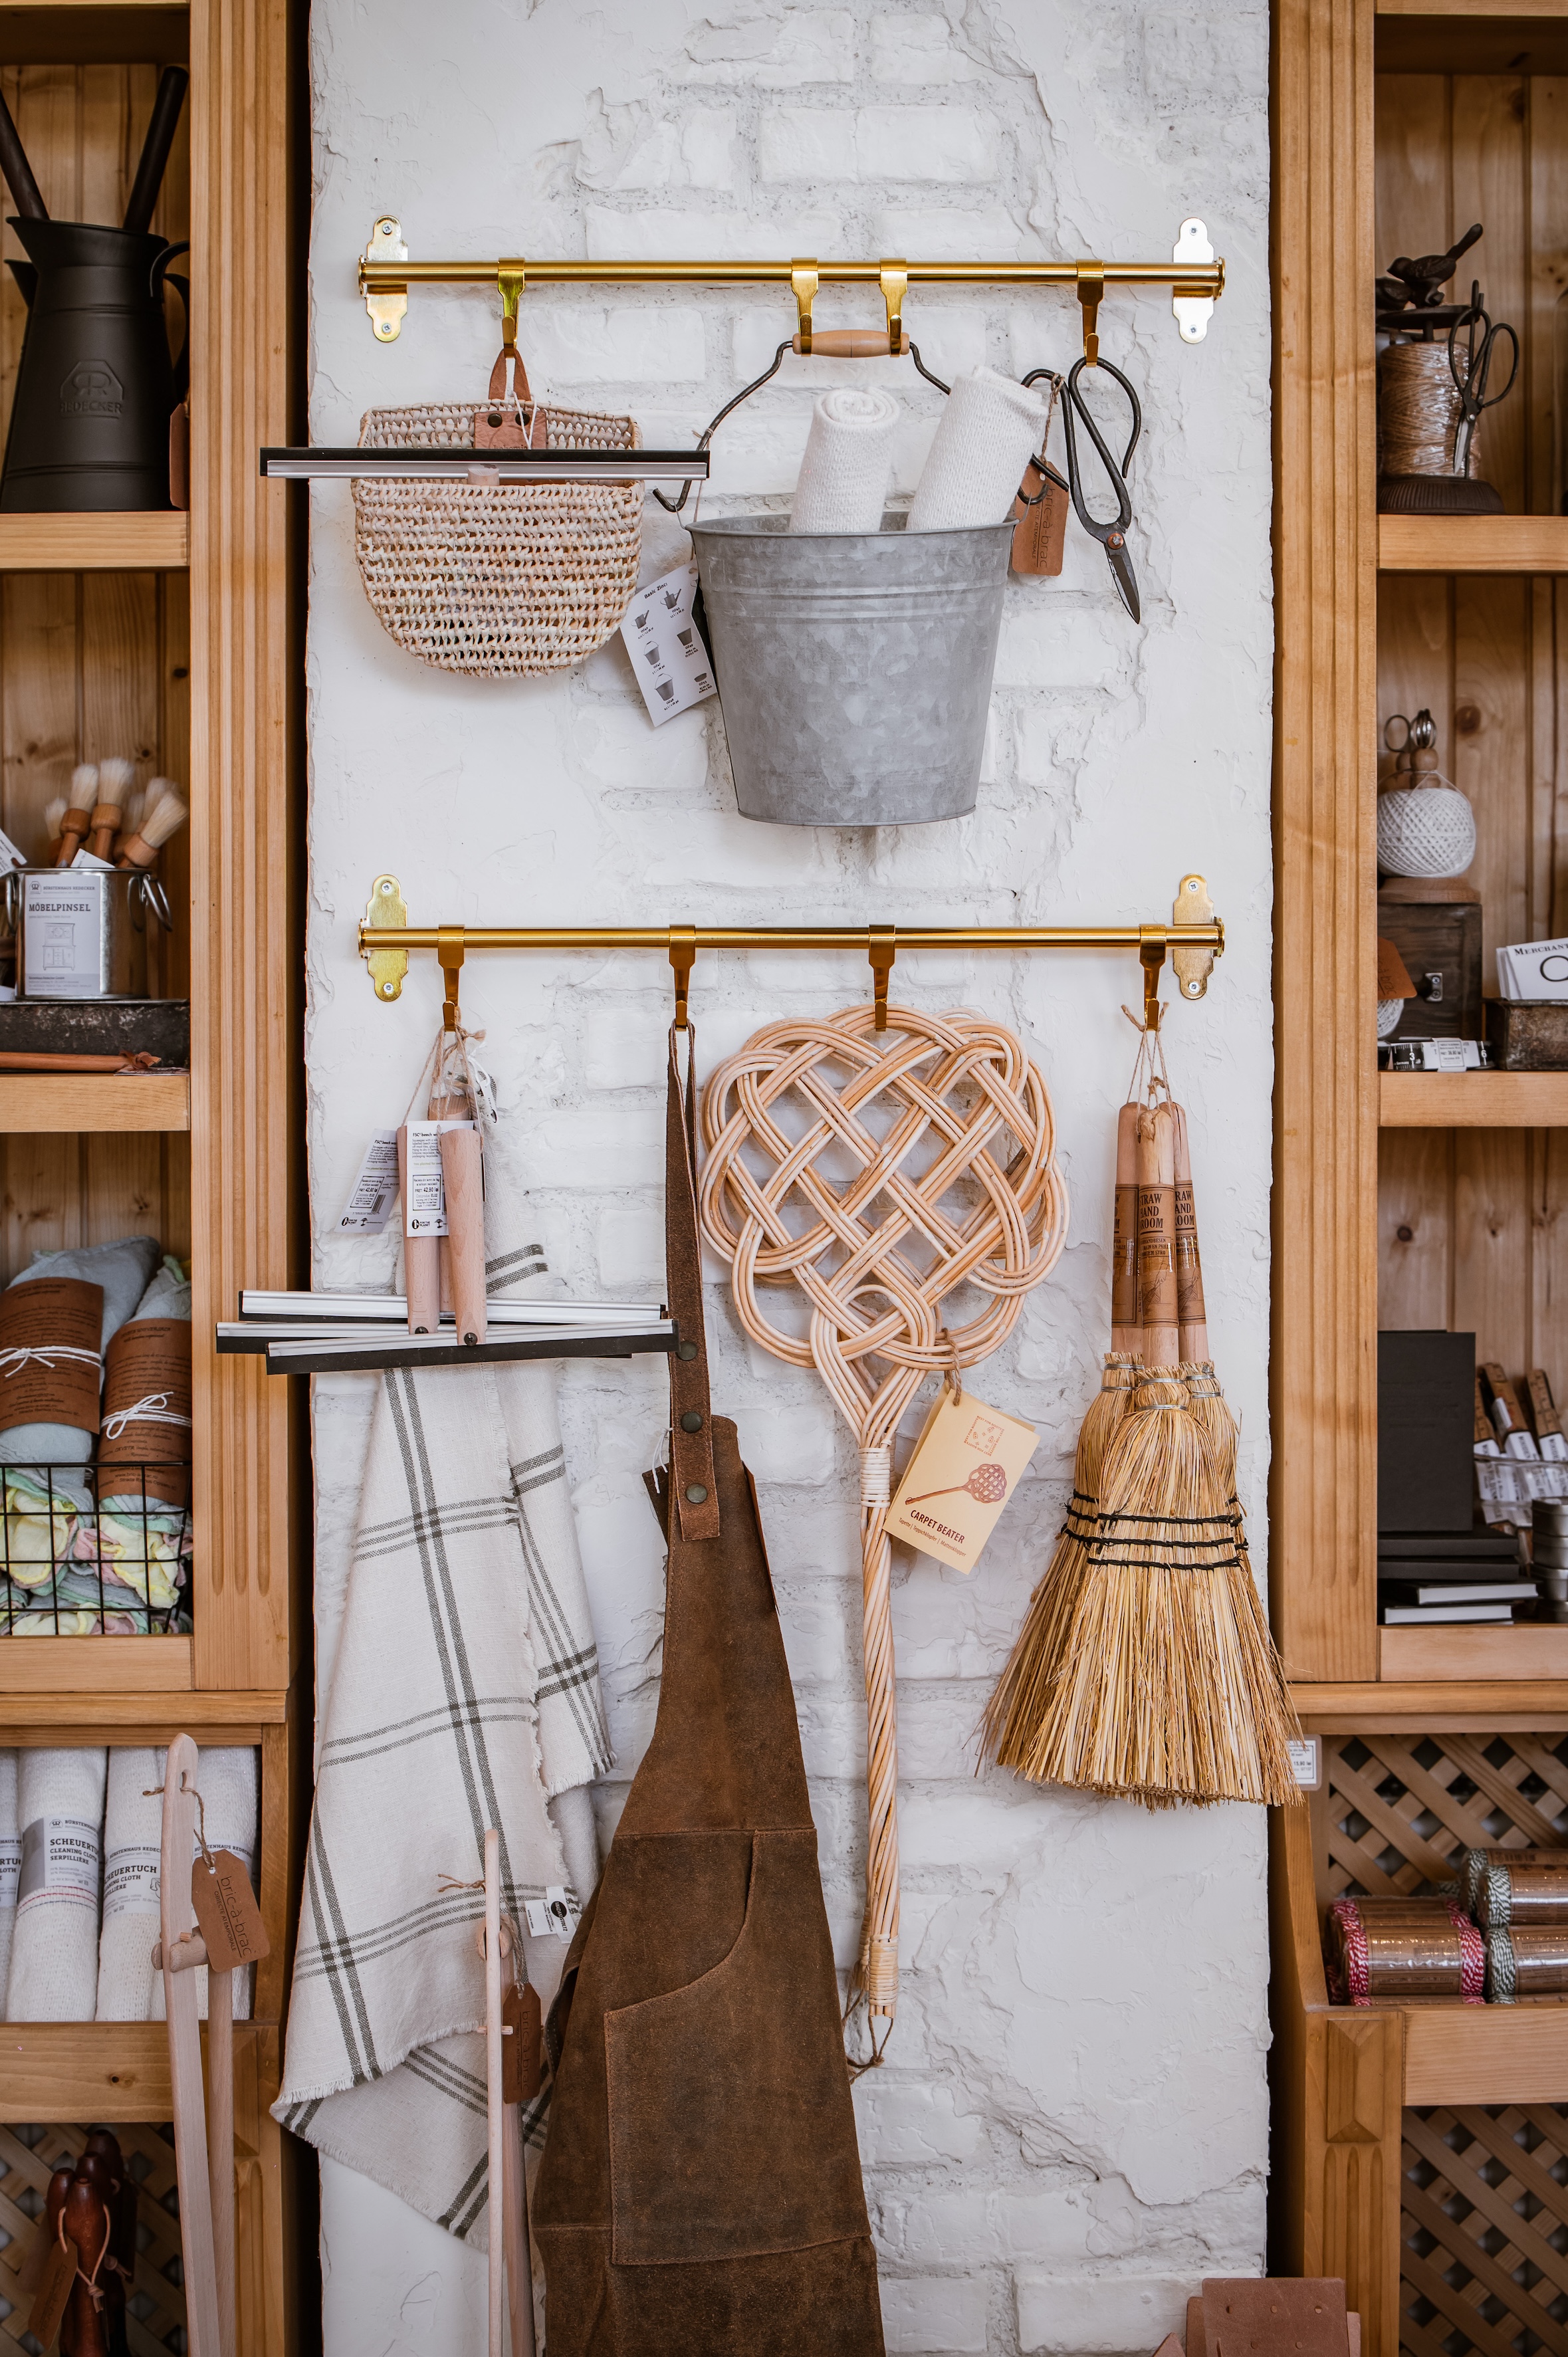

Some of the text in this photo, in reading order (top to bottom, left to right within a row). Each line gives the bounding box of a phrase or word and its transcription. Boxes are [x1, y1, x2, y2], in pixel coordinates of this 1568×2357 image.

[29, 902, 91, 911] MÖBELPINSEL
[899, 1517, 911, 1527] Tapette
[913, 1525, 937, 1541] Teppichklopfer
[910, 1510, 965, 1543] CARPET BEATER
[50, 1855, 89, 1865] SERPILLIÈRE
[214, 1890, 237, 1952] OBIECTE ATEMPORALE
[221, 1876, 252, 1956] bric-à-brac
[554, 1902, 564, 1918] MADAM
